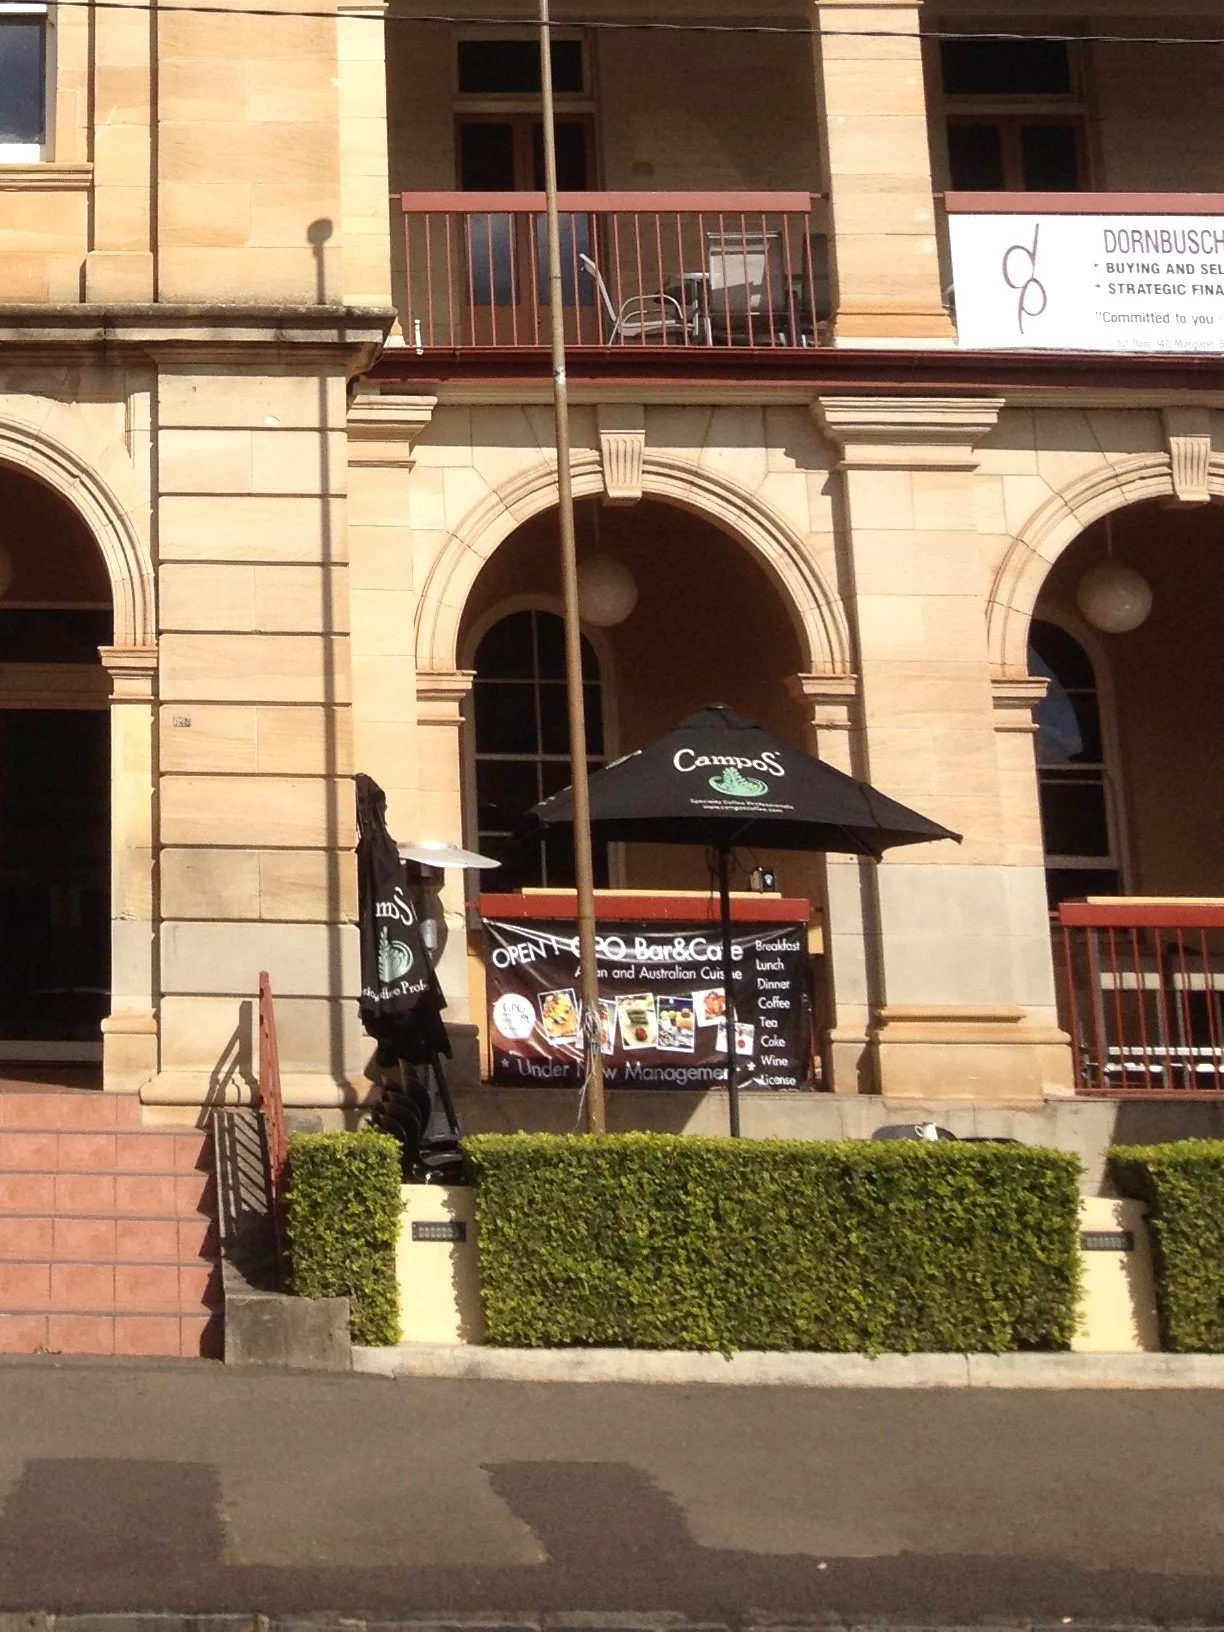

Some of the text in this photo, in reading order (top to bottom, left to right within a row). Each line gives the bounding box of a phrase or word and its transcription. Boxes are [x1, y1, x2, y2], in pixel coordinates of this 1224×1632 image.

[1106, 262, 1160, 273] BUYING
[1166, 263, 1195, 274] AND
[1108, 283, 1186, 295] STRATEGIC
[1176, 313, 1186, 324] to
[1191, 315, 1214, 327] you
[755, 939, 801, 952] Breakfast
[755, 957, 785, 971] Lunch
[611, 963, 635, 979] and
[639, 964, 697, 980] Australian
[757, 977, 791, 990] Dinner
[757, 996, 791, 1009] Coffee
[759, 1016, 779, 1028] Tea
[760, 1035, 786, 1048] Cake
[517, 1057, 570, 1078] Under
[760, 1055, 789, 1067] Wine
